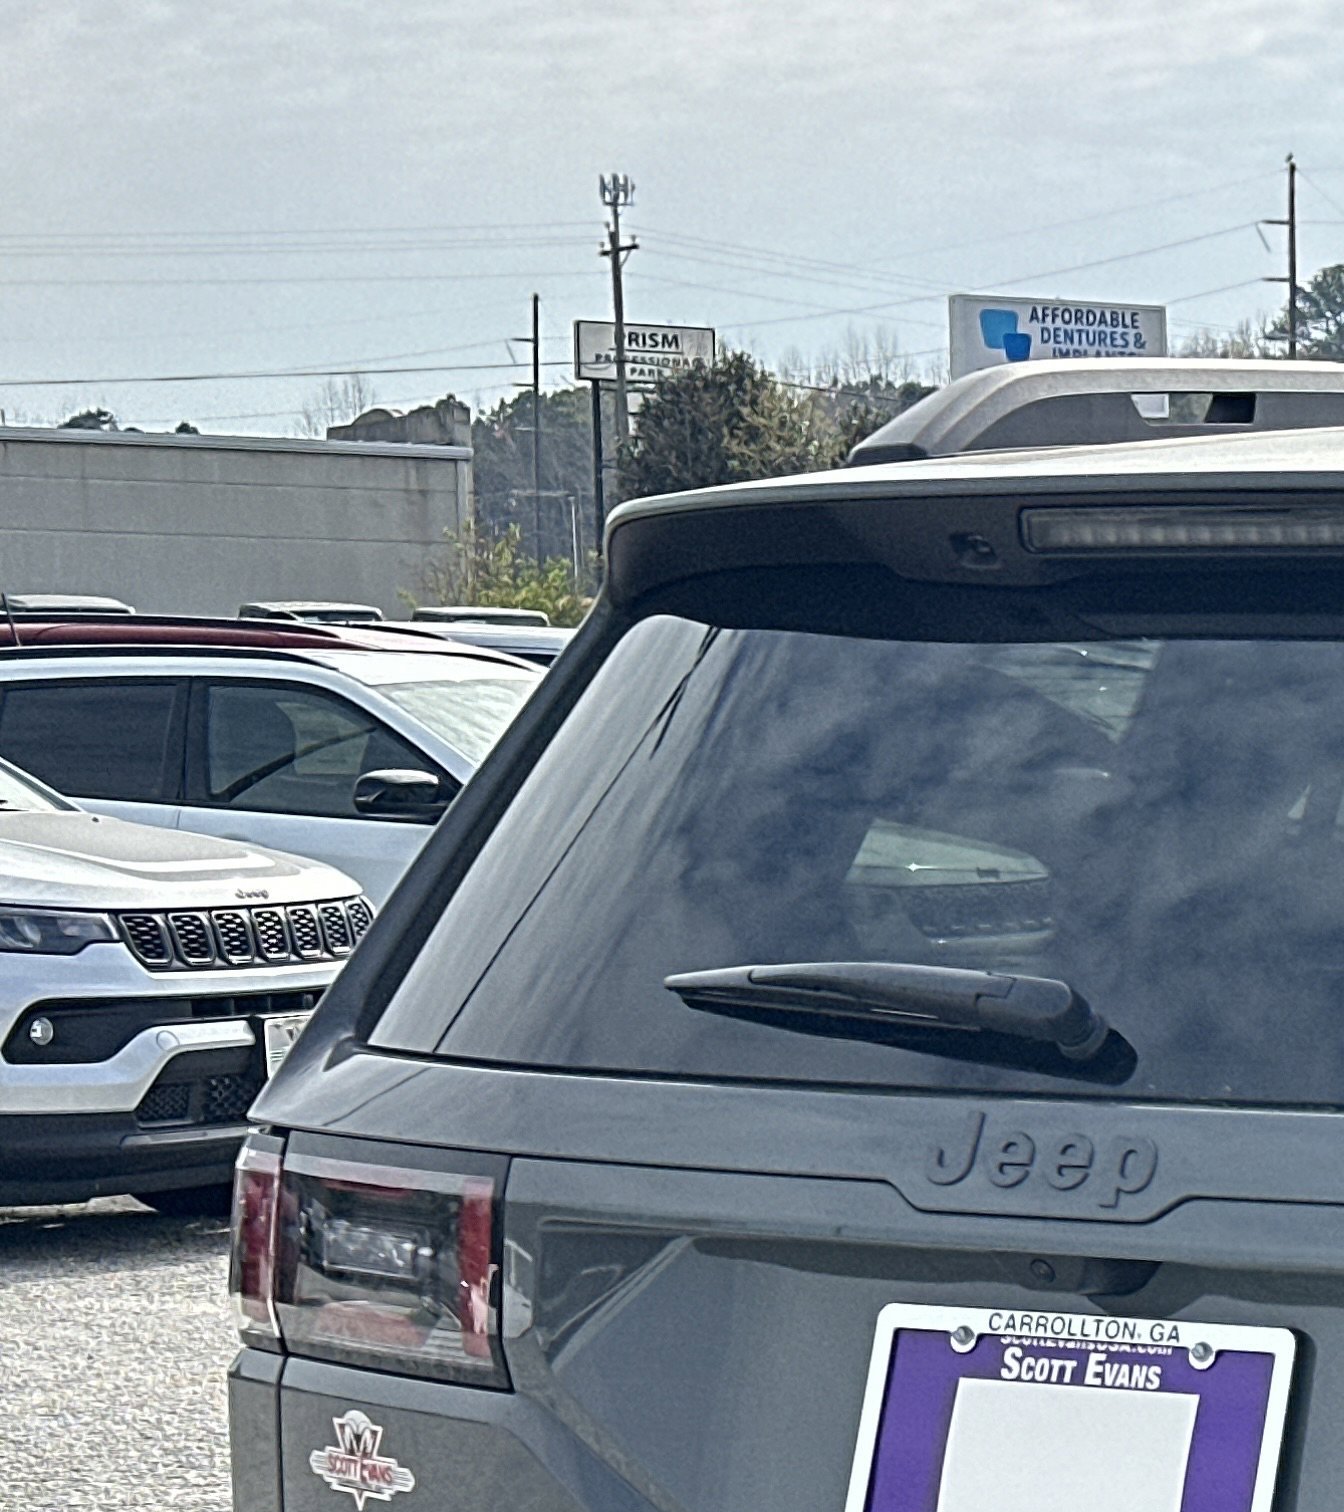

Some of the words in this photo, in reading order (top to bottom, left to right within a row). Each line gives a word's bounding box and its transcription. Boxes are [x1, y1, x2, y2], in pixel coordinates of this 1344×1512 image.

[1029, 306, 1140, 329] AFFORDABLE
[624, 331, 680, 349] RISM
[1041, 327, 1130, 348] DENTURES
[1134, 332, 1147, 349] &
[928, 1111, 1158, 1208] Jeep
[1150, 1323, 1181, 1343] GA
